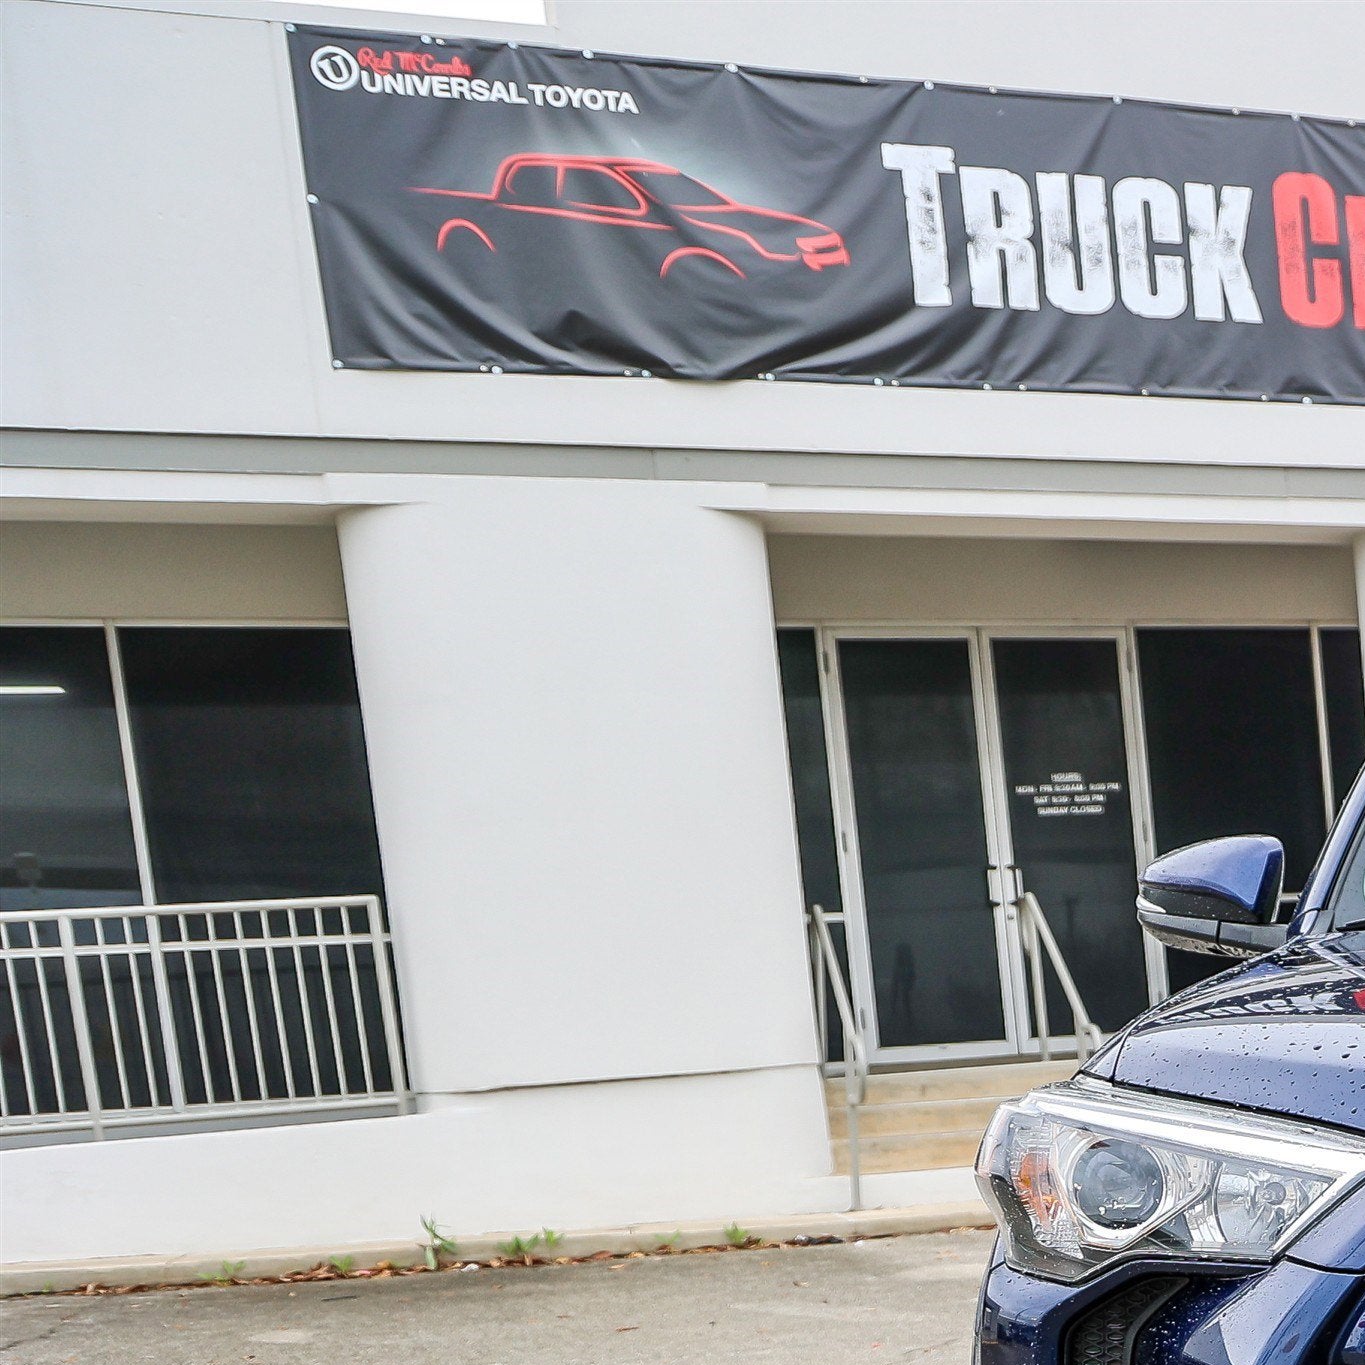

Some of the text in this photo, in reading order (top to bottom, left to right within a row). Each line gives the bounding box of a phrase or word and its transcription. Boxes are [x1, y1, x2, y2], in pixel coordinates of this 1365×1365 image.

[356, 46, 394, 76] Red
[360, 69, 641, 115] UNIVERSAL TOYOTA
[880, 141, 1264, 326] TRUCK
